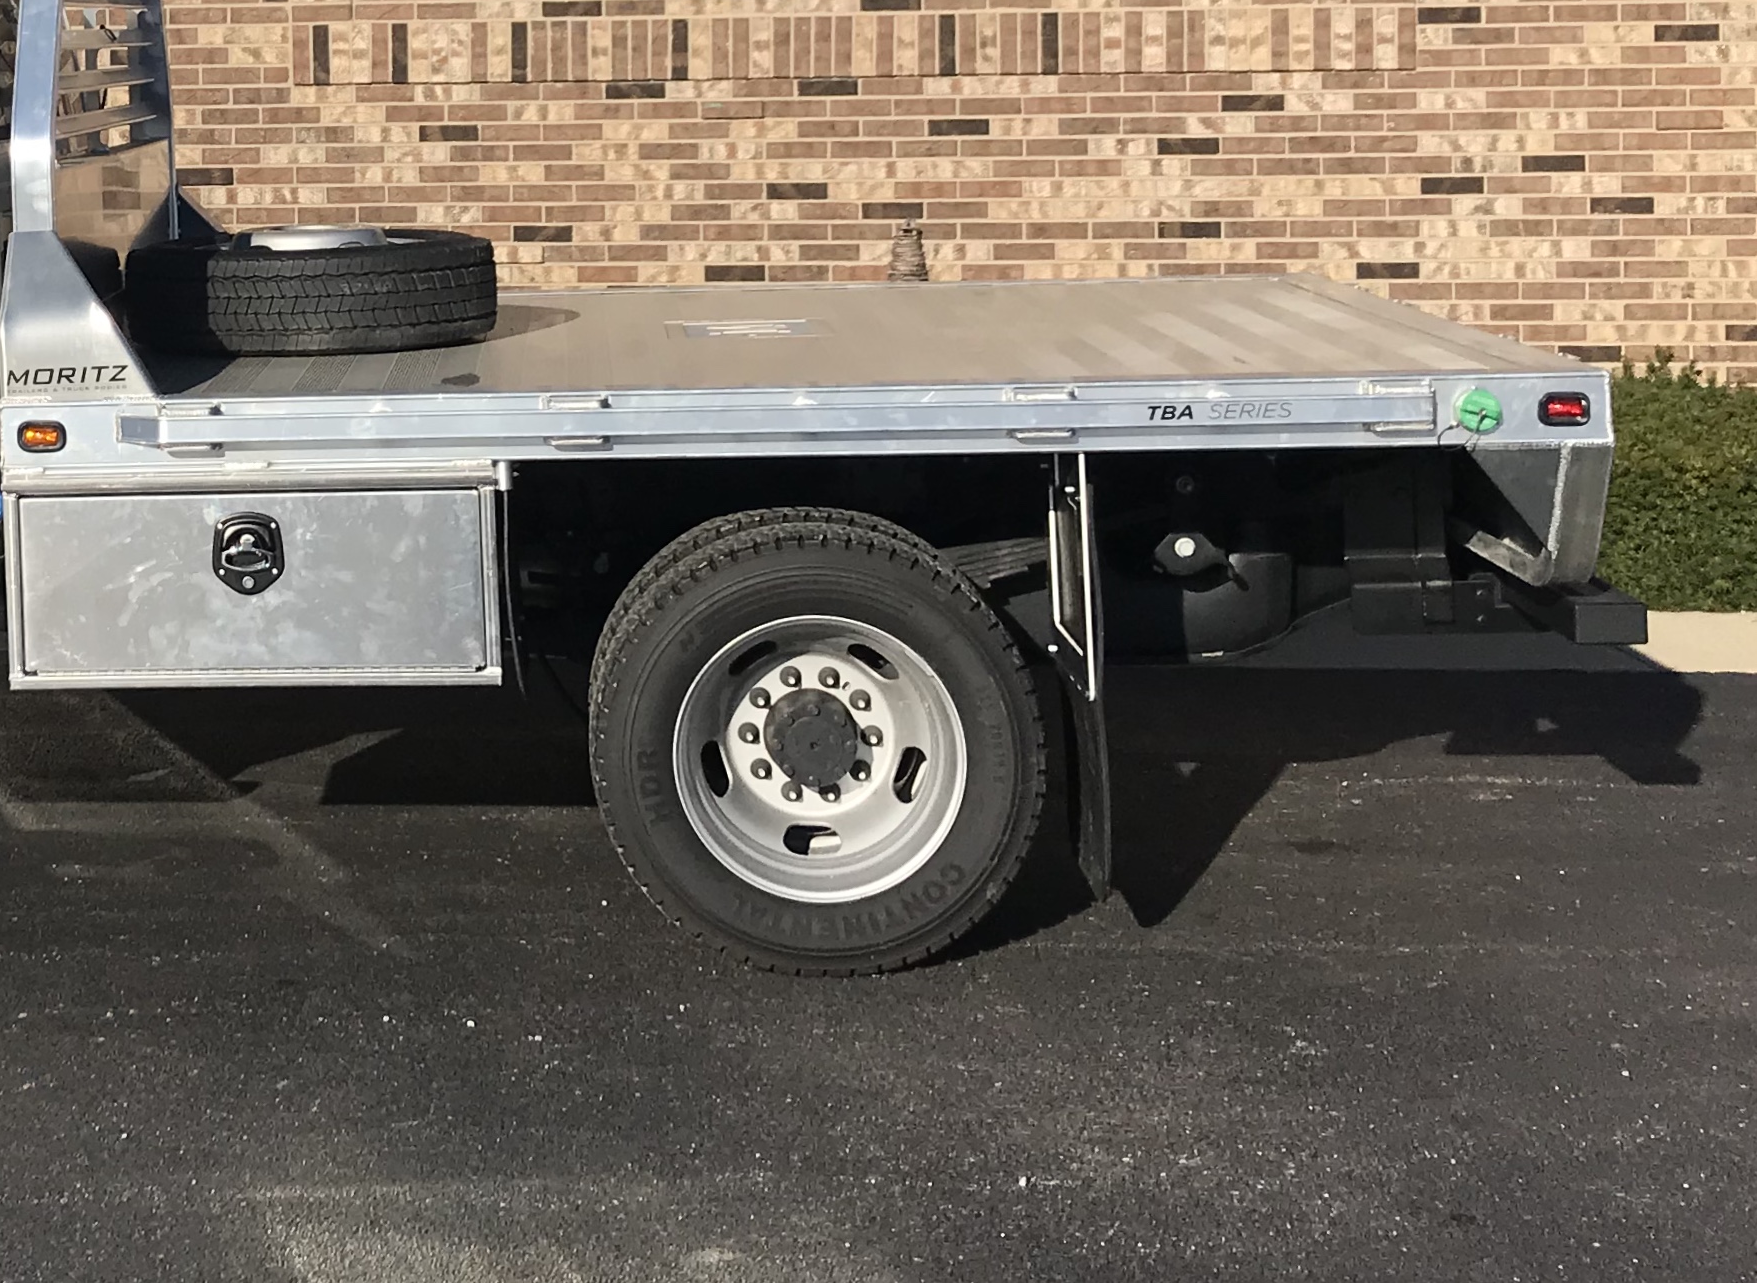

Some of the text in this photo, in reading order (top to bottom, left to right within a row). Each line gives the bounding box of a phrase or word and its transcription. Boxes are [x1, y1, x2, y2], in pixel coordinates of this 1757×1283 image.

[7, 365, 129, 386] MORITZ
[1147, 402, 1293, 421] TBA SERIES
